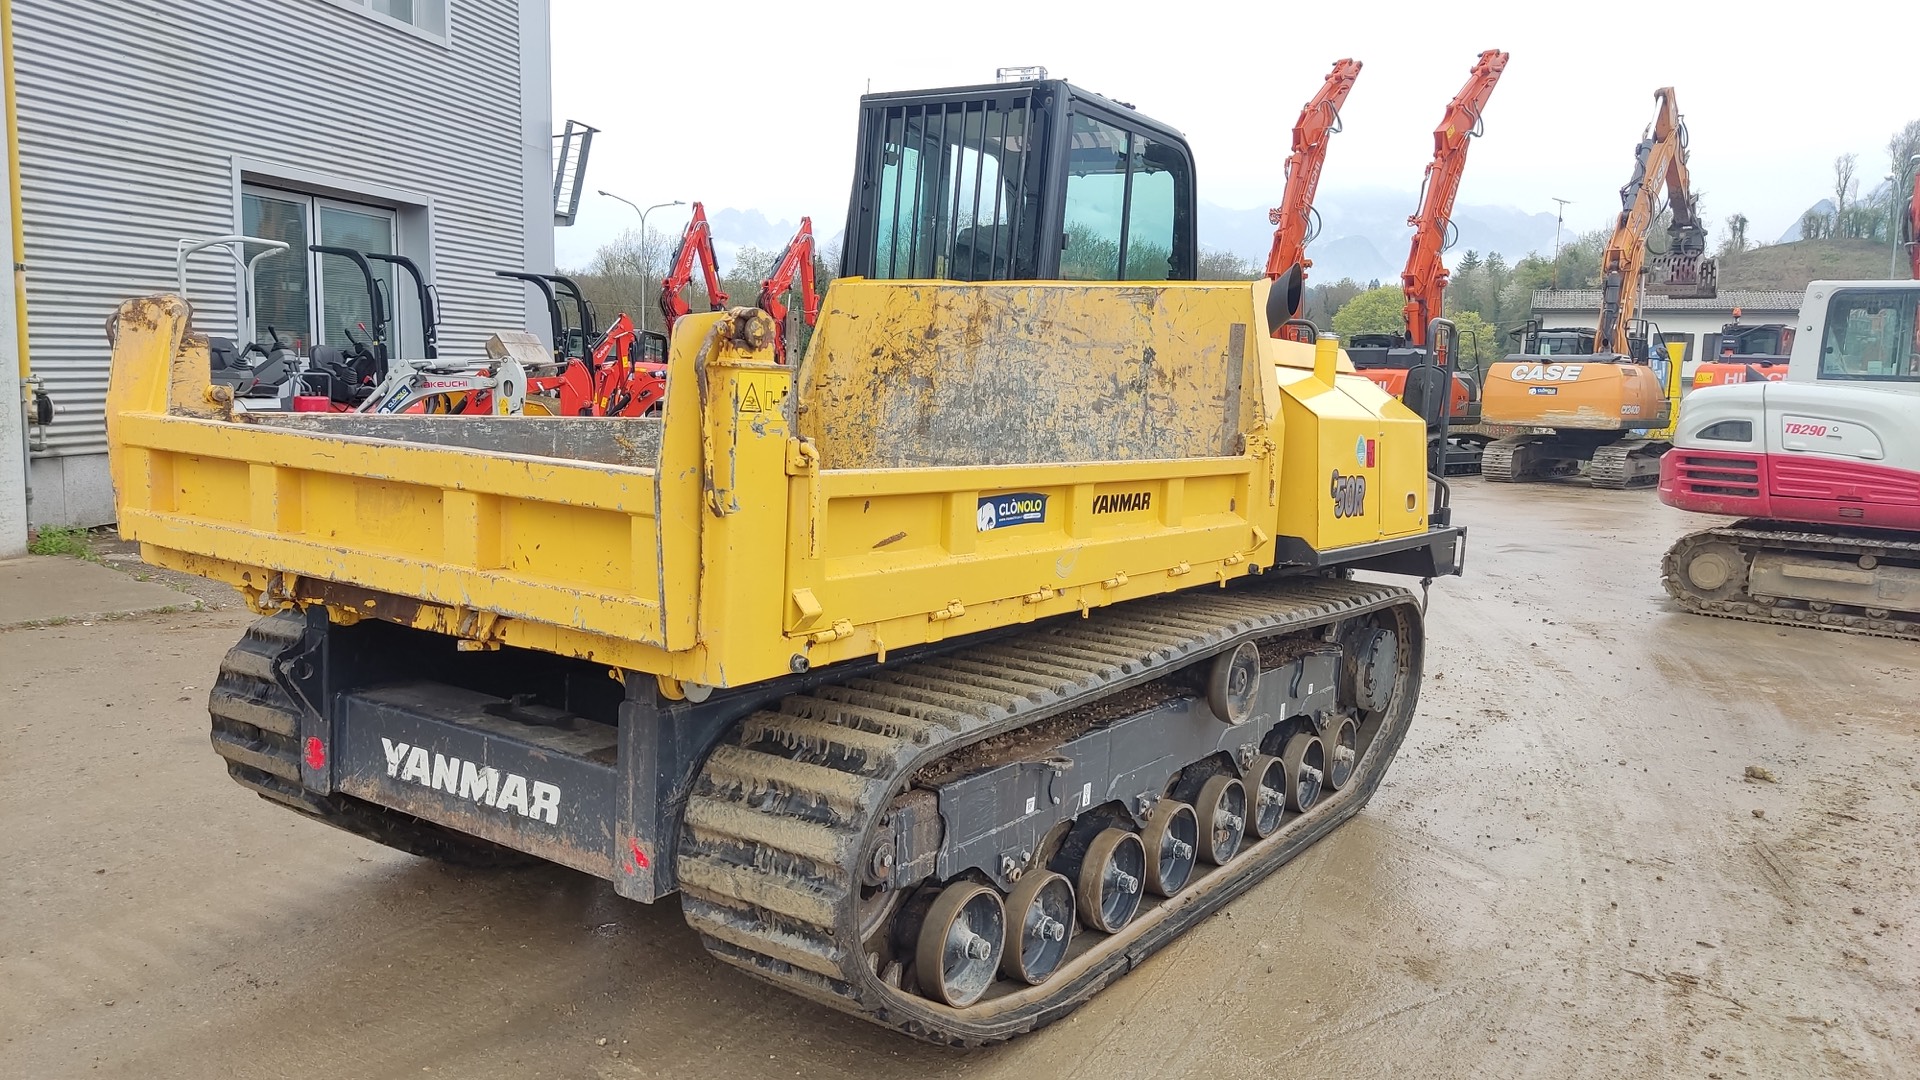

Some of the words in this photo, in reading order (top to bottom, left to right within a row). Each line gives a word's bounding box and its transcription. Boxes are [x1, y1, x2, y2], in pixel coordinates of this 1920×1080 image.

[1511, 365, 1583, 381] CASE
[421, 380, 468, 389] AKEUCHI
[1785, 423, 1827, 437] TB290
[998, 499, 1042, 516] CLÒNOLO
[1092, 491, 1151, 514] YANMAR
[381, 736, 562, 826] YANMAR
